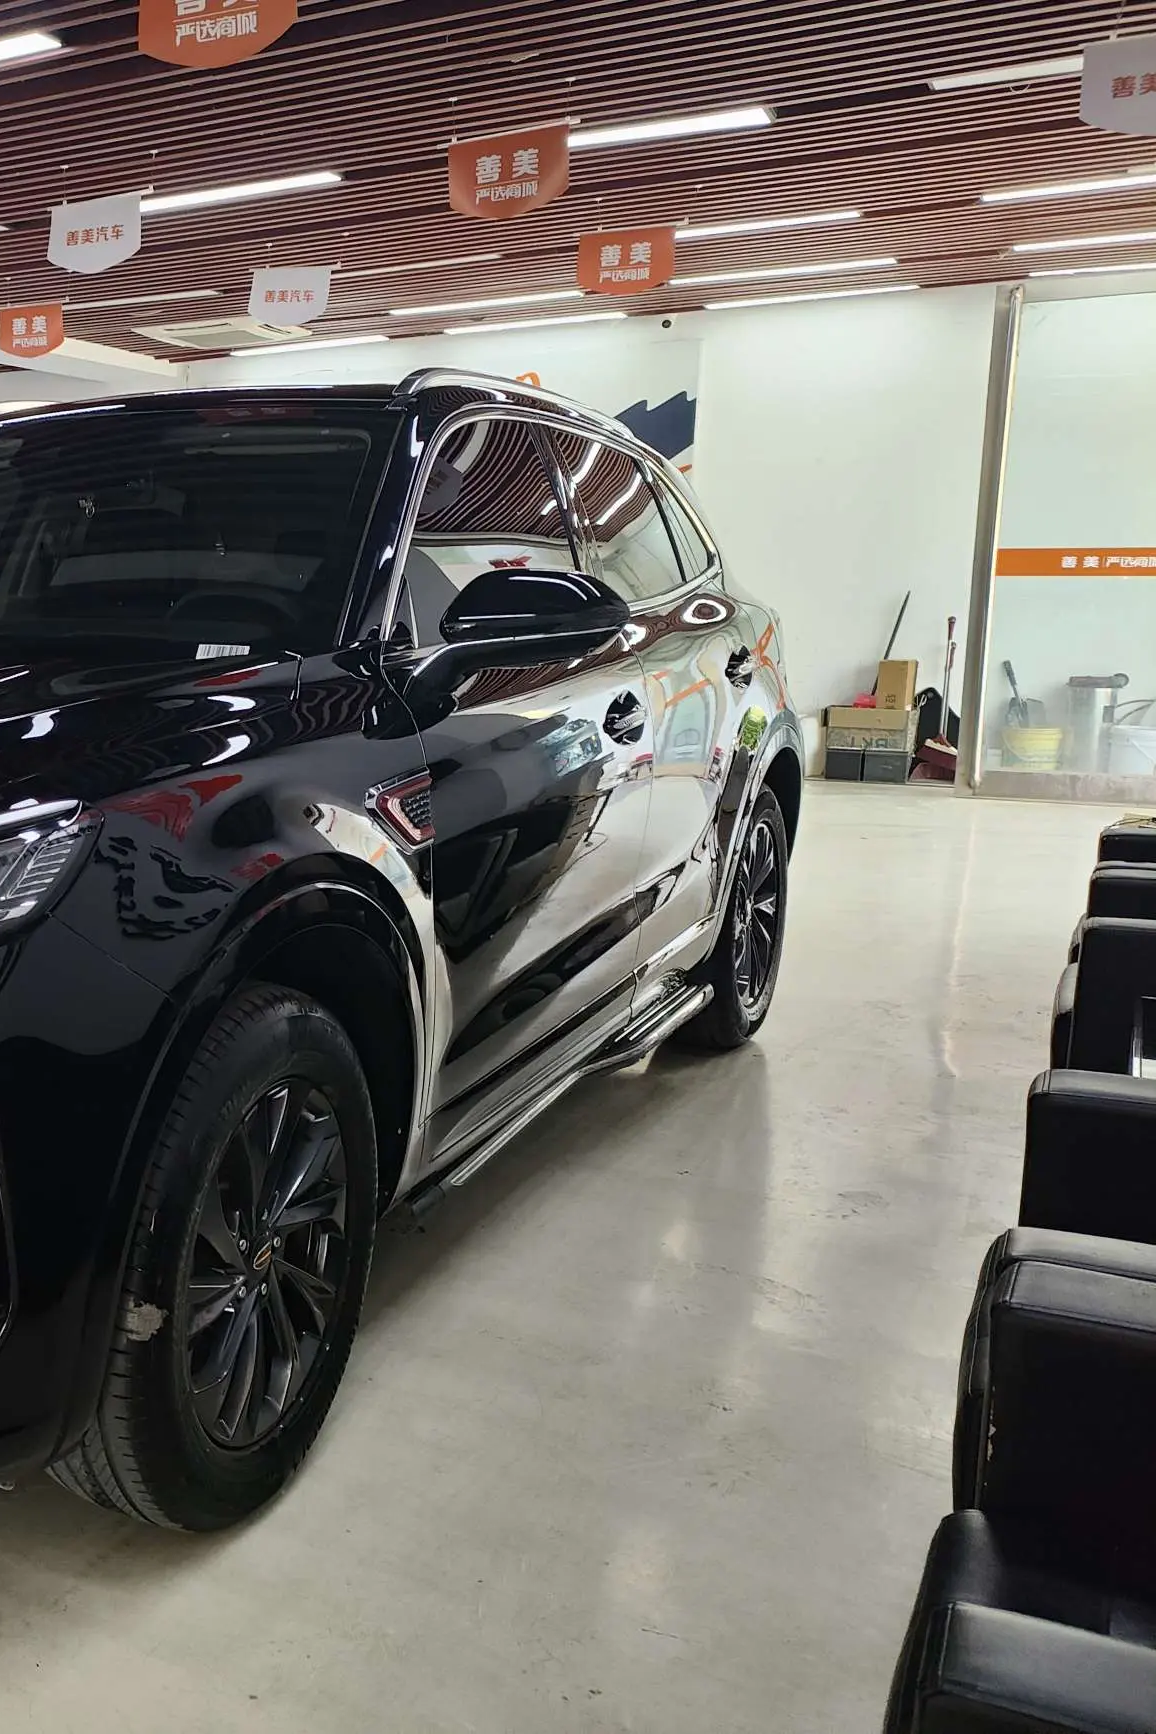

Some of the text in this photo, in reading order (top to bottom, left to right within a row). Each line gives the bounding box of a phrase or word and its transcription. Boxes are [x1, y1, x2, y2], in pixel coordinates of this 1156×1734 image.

[175, 11, 258, 47] 严选商城
[476, 147, 539, 184] 善美
[475, 180, 539, 205] 严选商城
[66, 224, 124, 246] 善美汽车
[599, 241, 652, 267] 善美
[599, 267, 650, 284] 严选商城
[264, 289, 315, 303] 善美汽车
[11, 315, 47, 335] 善美
[1061, 556, 1100, 568] 善美
